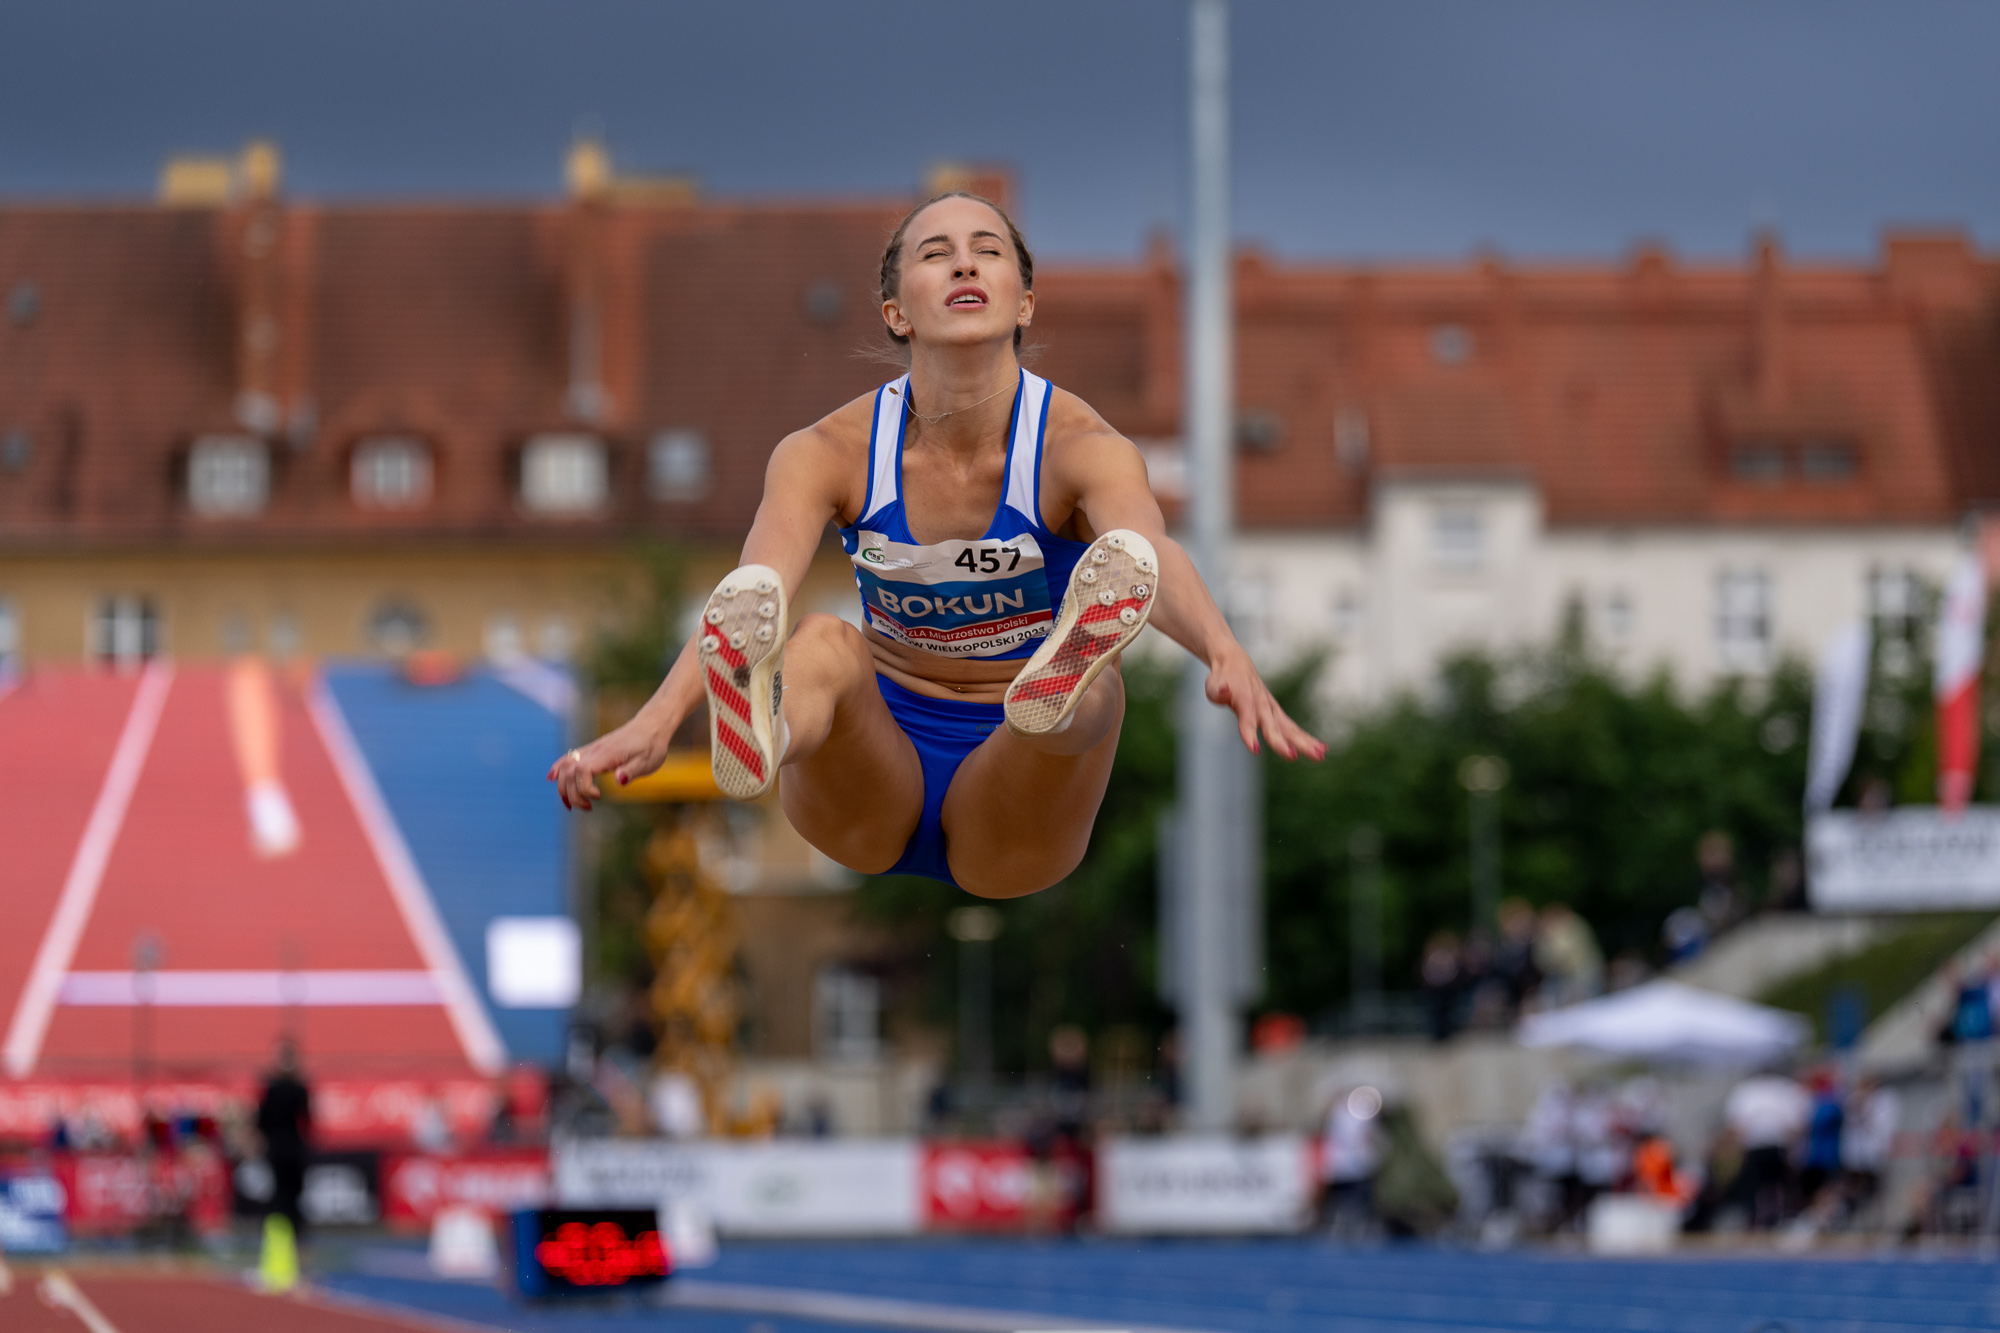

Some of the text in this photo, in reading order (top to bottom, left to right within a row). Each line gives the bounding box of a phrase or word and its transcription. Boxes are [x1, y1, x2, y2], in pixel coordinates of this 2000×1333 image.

[954, 547, 1021, 574] 457
[877, 588, 1025, 618] BOKUN
[926, 635, 1015, 653] WIELKOPOLSKI
[1017, 626, 1046, 642] 2023
[929, 626, 994, 641] Mistrzostwa
[997, 617, 1028, 632] Polski
